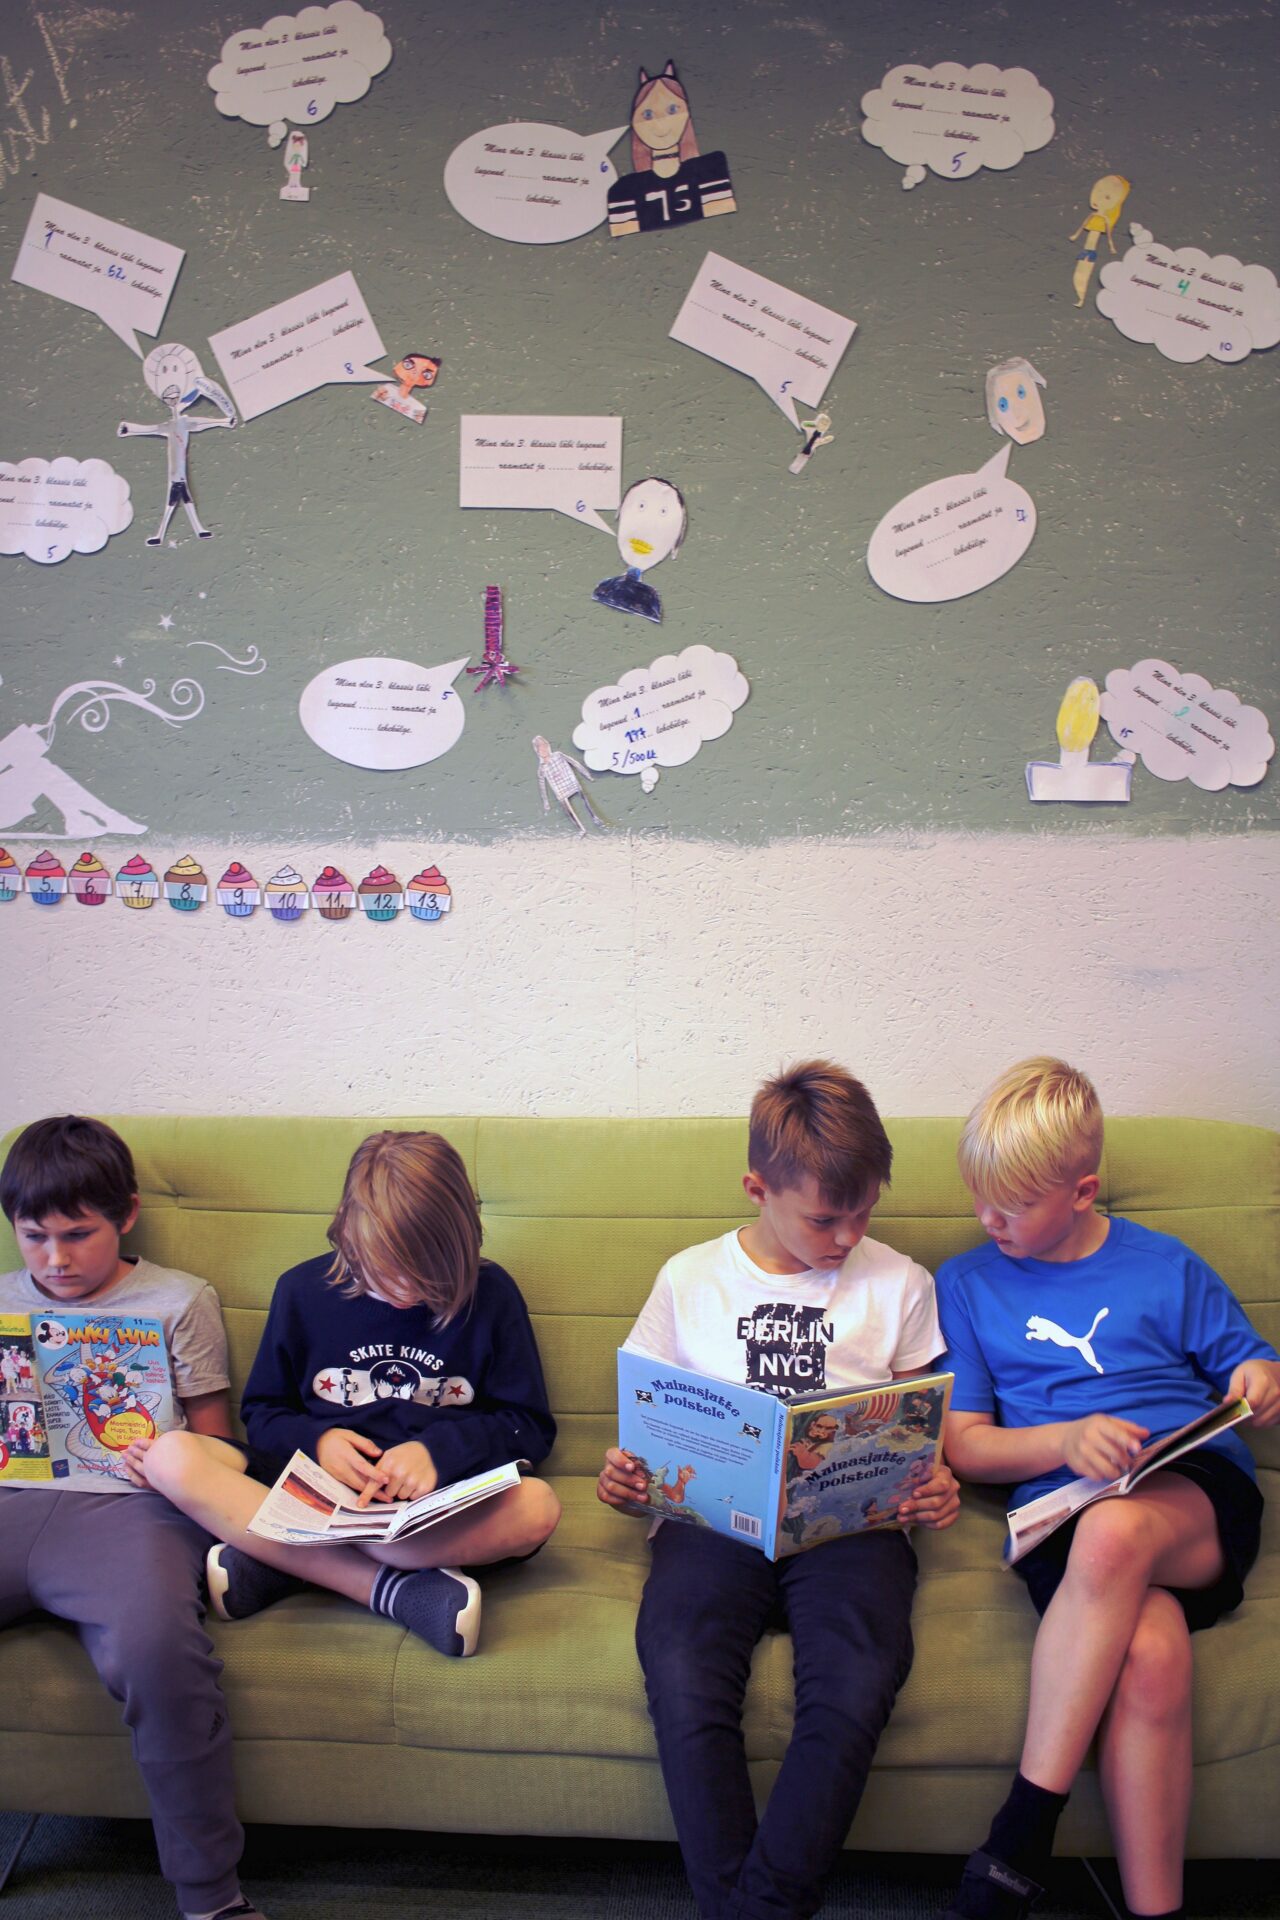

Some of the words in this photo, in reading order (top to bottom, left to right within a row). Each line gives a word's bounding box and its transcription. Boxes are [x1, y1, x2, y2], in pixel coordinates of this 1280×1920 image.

[307, 99, 318, 116] 6
[600, 160, 609, 173] 6
[952, 151, 967, 172] 5
[1177, 279, 1191, 296] 4
[1219, 341, 1233, 351] 10
[780, 381, 793, 394] 5
[576, 500, 586, 512] 6
[47, 545, 58, 558] 5
[441, 691, 454, 700] 5
[633, 707, 641, 718] 1
[39, 875, 54, 893] 5.
[130, 880, 144, 899] 7.
[180, 882, 194, 901] 8.
[233, 888, 247, 906] 9.
[326, 891, 345, 908] 11.
[373, 893, 397, 909] 12.
[417, 893, 440, 910] 13.
[737, 1317, 834, 1344] BERLIN
[349, 1344, 394, 1363] SKATE
[400, 1345, 445, 1371] KINGS
[759, 1353, 814, 1377] NYC
[651, 1379, 741, 1418] Muinasjutte
[664, 1393, 726, 1420] poistele
[805, 1451, 906, 1485] Muinasjutte
[818, 1466, 889, 1491] poistele
